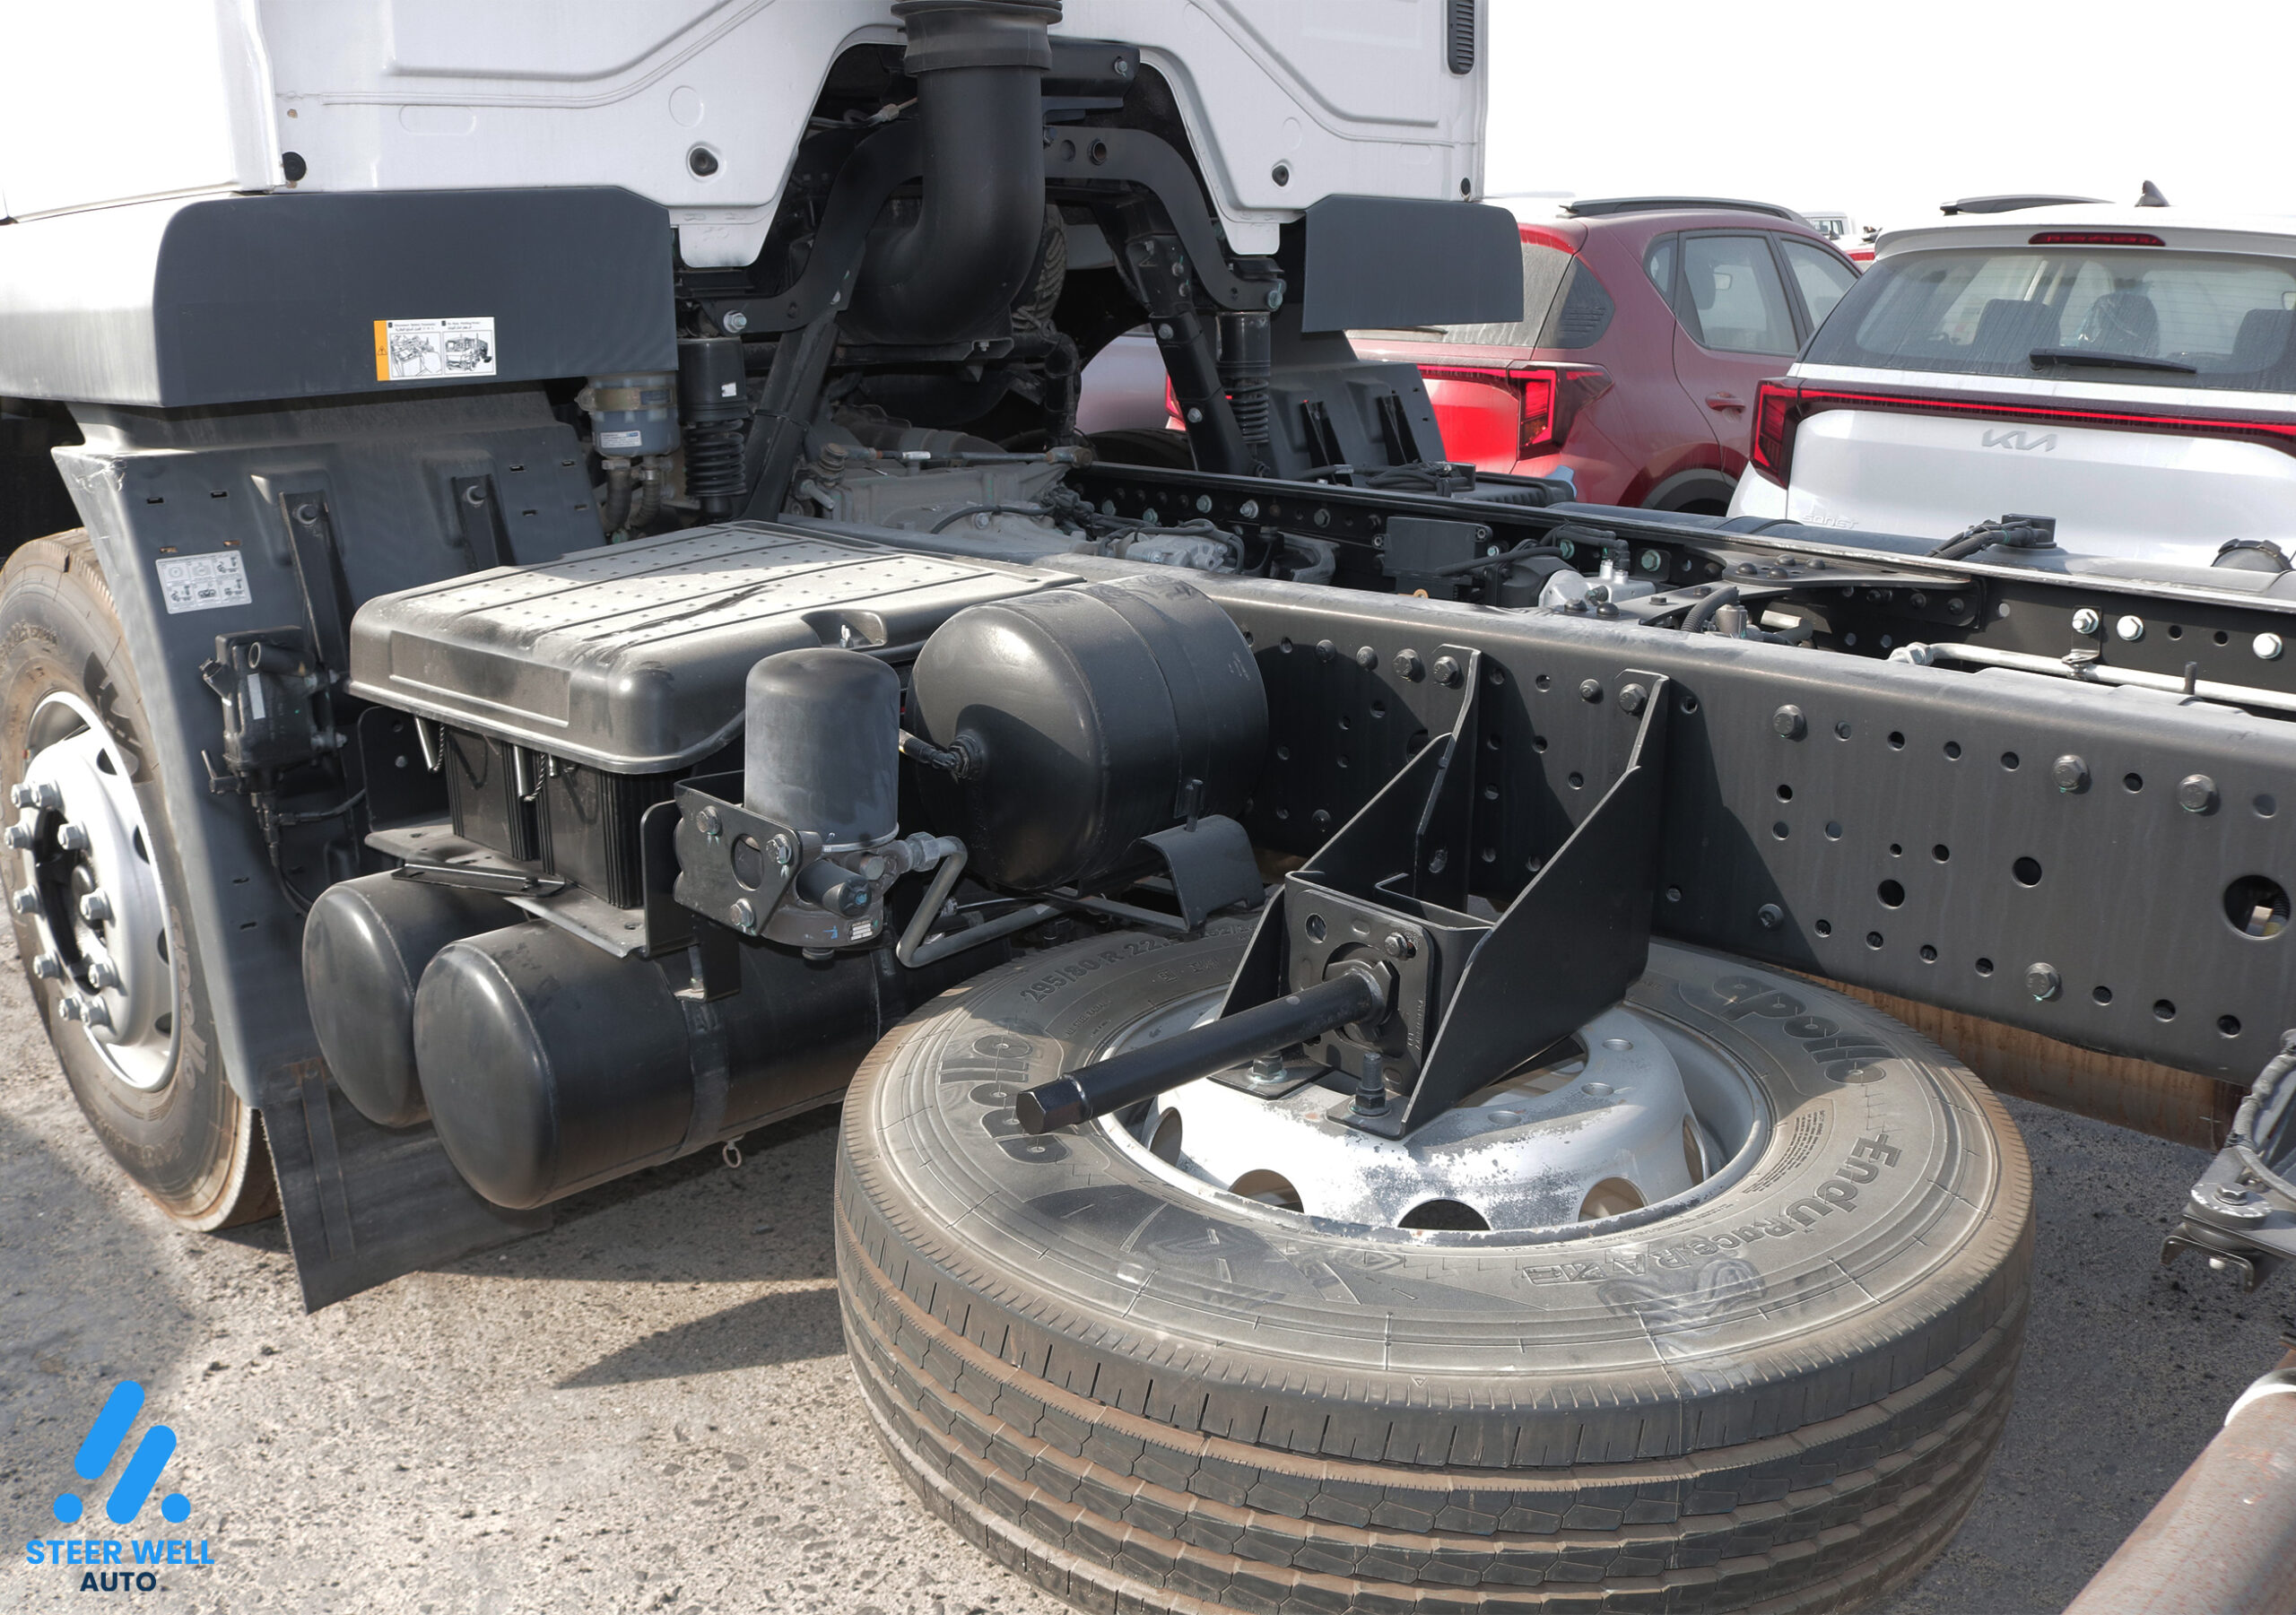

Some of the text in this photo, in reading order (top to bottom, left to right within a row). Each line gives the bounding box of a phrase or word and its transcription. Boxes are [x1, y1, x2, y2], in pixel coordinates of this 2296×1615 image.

[1980, 428, 2058, 453] KIA
[1020, 959, 1101, 1003] 295/80
[1098, 949, 1124, 965] R
[1712, 975, 1900, 1085] apollo
